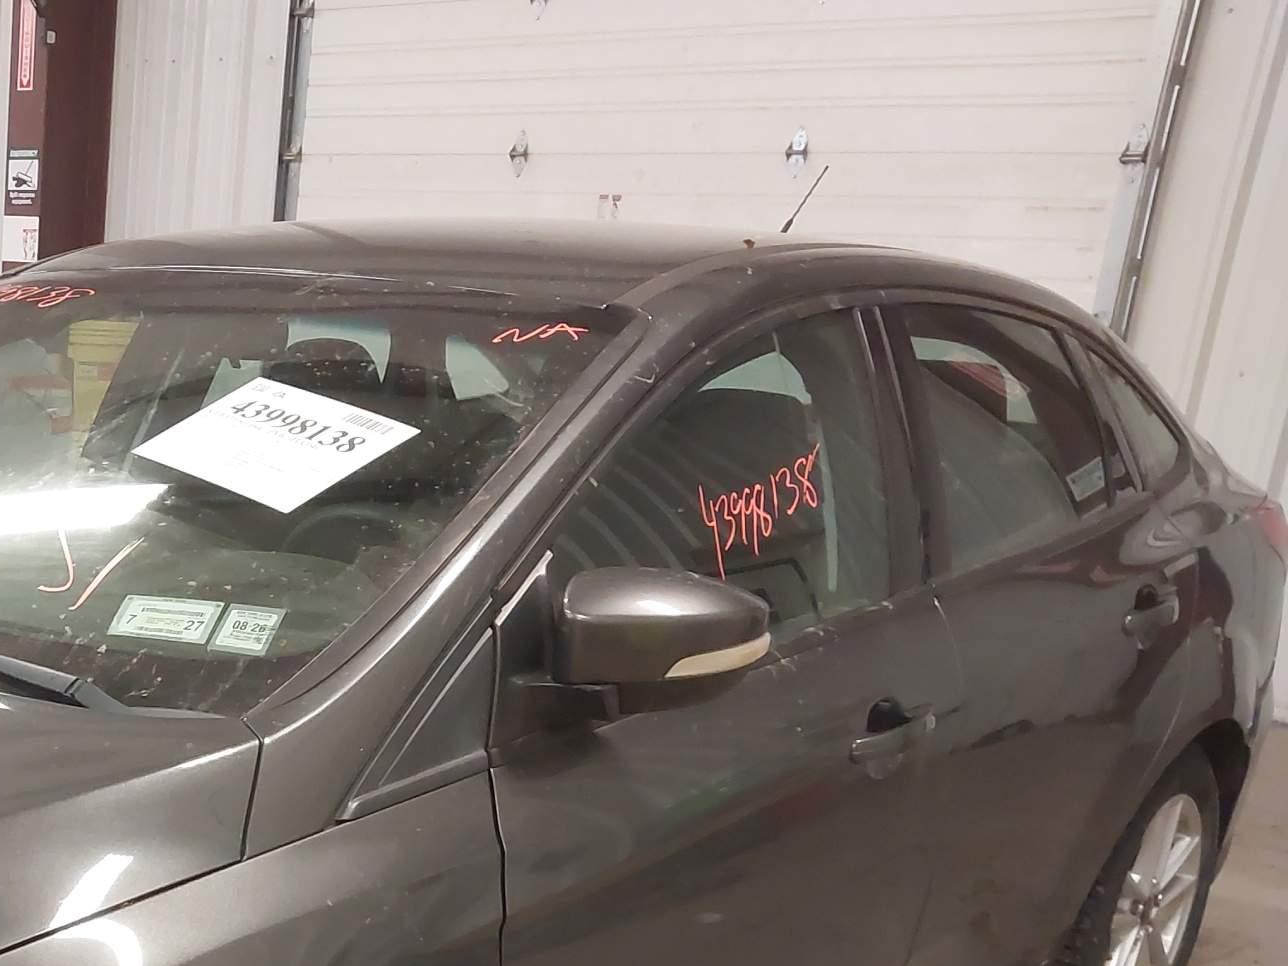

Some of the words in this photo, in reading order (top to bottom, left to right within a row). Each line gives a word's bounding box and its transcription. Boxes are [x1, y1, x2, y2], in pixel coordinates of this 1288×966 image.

[492, 322, 590, 344] NA
[231, 400, 367, 453] 43998138
[698, 442, 821, 581] 43998138
[183, 620, 206, 632] 27
